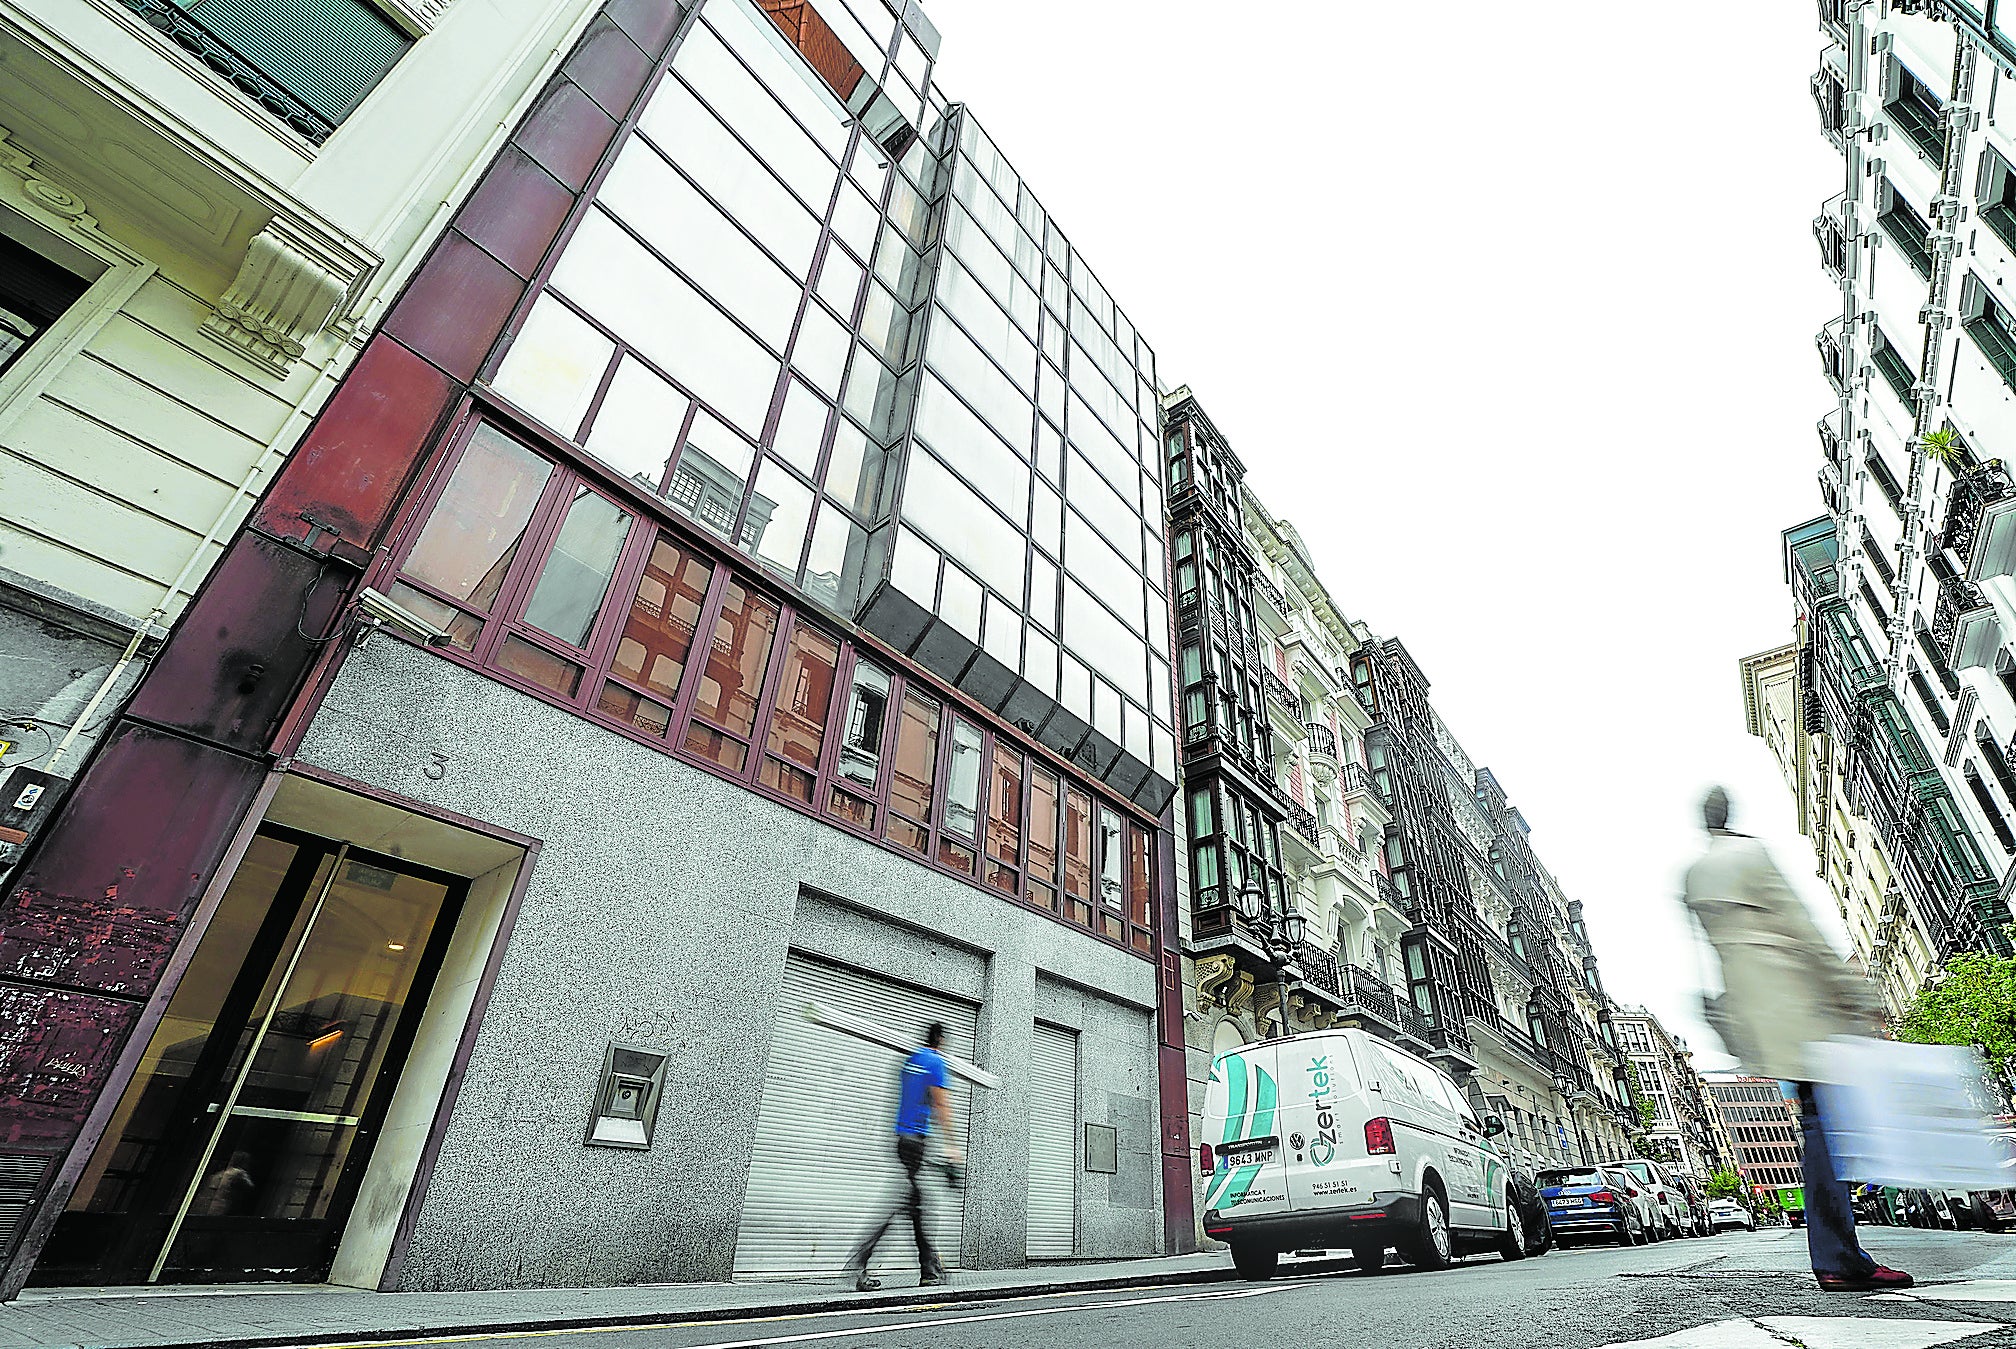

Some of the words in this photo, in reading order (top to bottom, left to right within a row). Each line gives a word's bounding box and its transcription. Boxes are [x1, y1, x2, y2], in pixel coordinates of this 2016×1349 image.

[423, 751, 450, 780] 3
[1306, 1055, 1337, 1145] zertek
[1229, 1153, 1252, 1166] 9643
